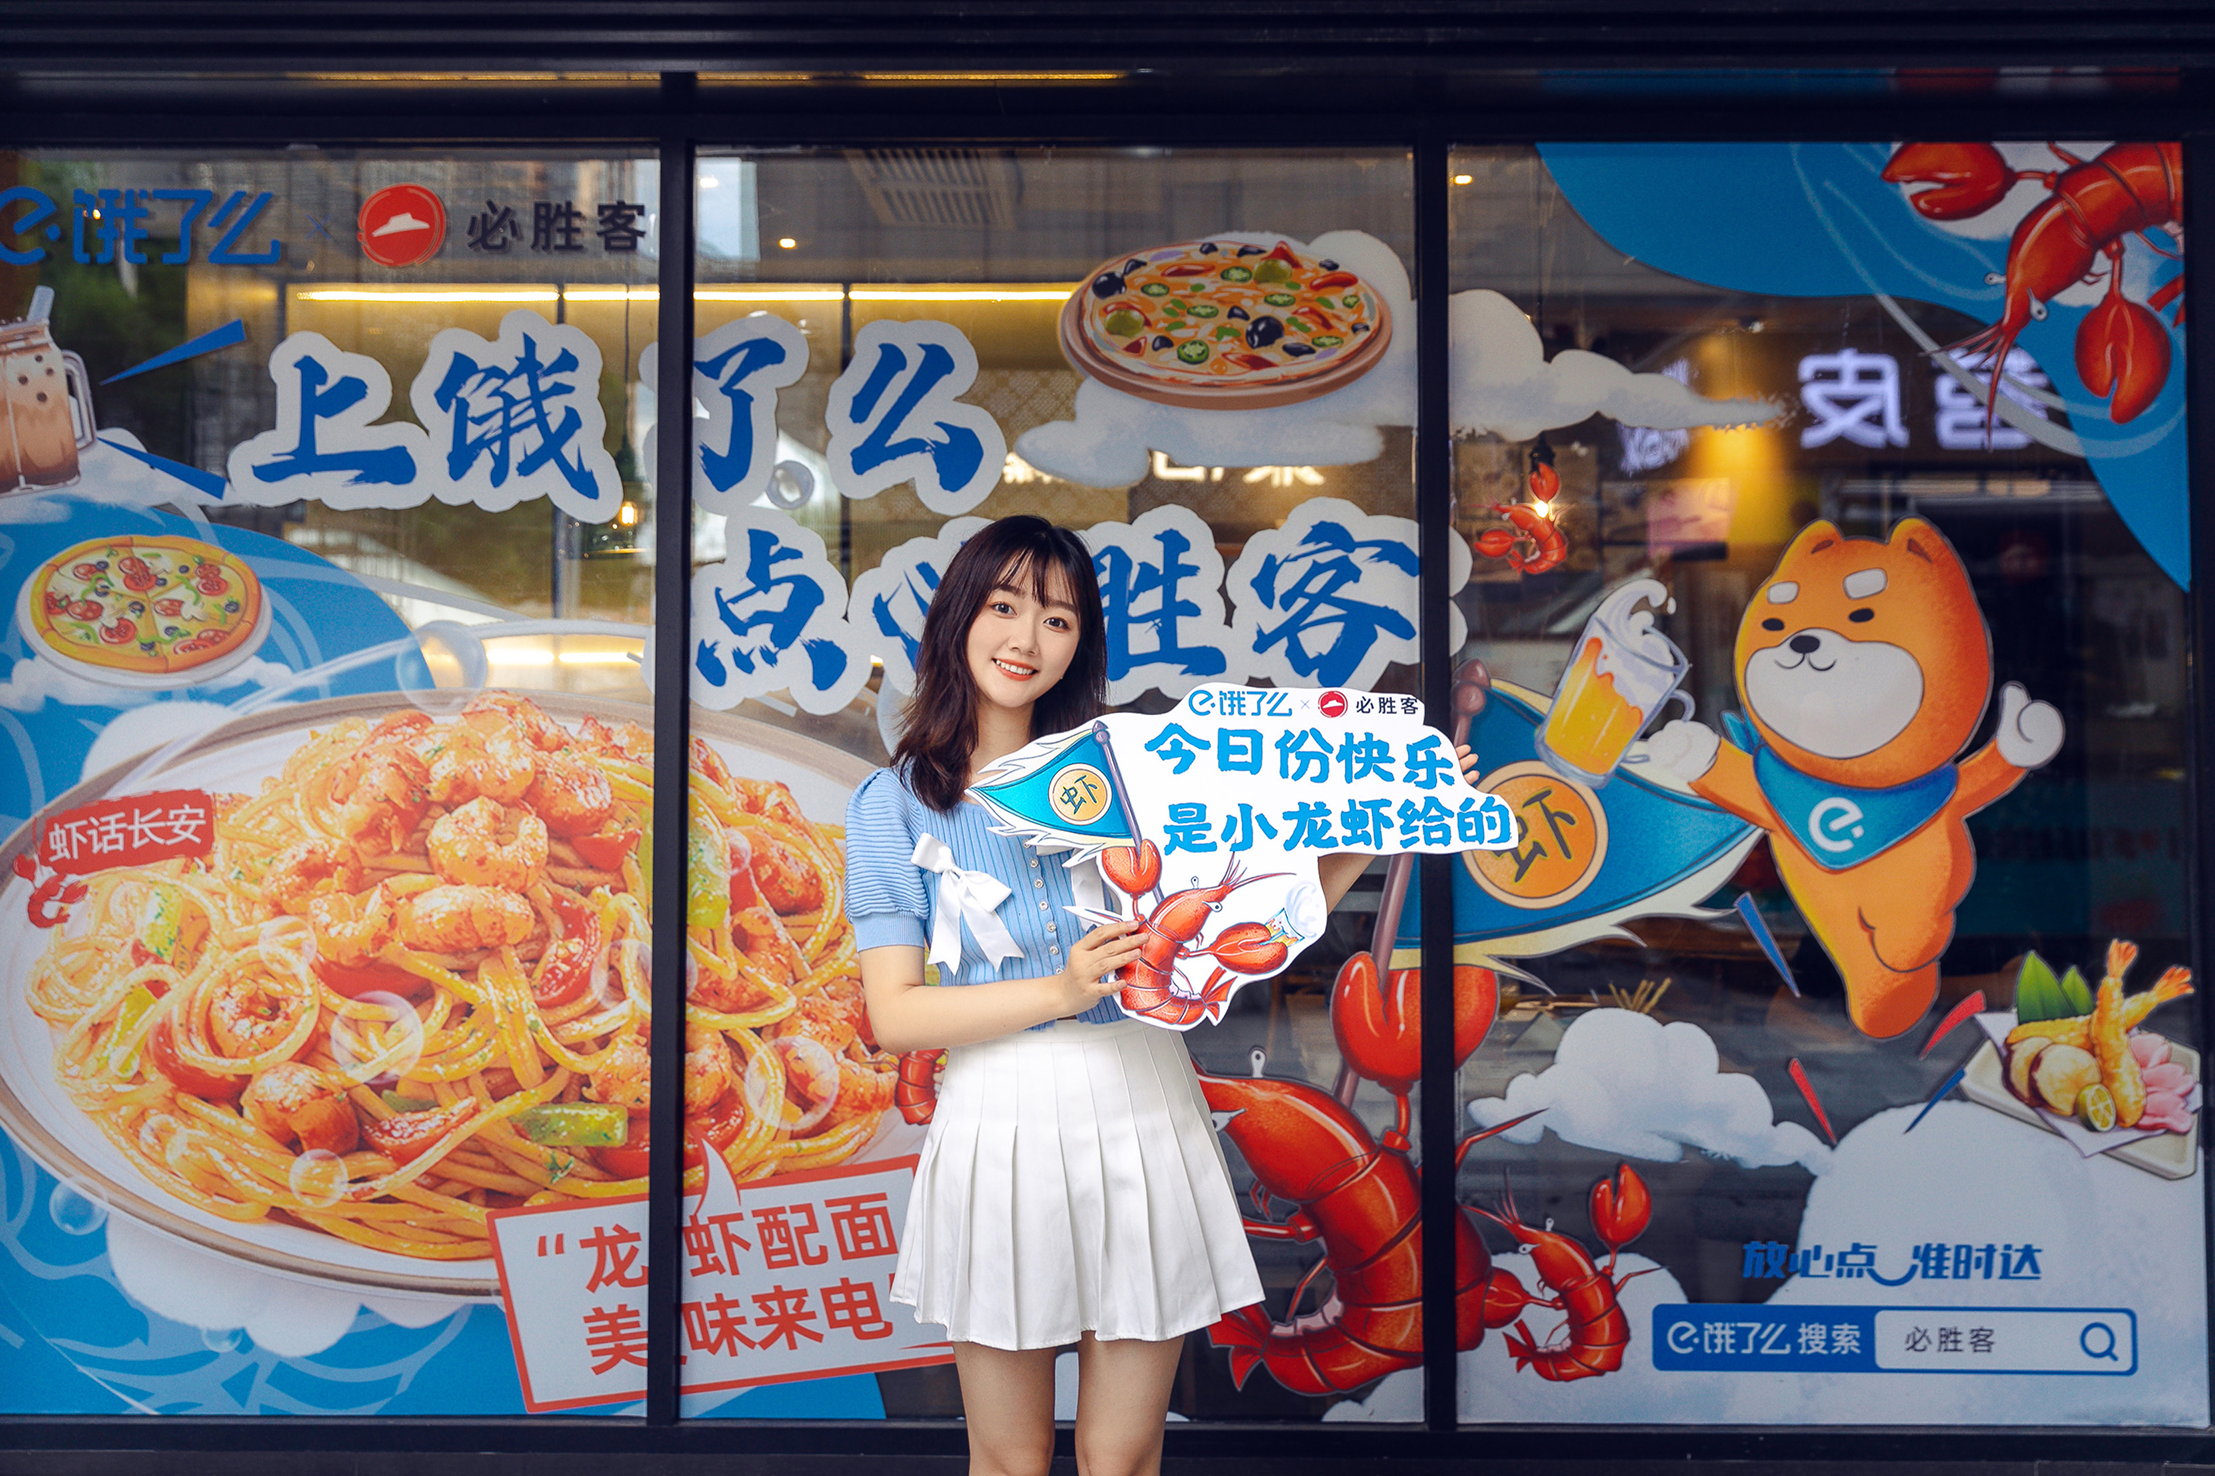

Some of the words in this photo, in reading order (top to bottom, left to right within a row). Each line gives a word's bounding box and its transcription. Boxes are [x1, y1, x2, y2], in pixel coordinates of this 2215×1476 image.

[467, 201, 647, 253] 必胜客
[696, 520, 1420, 688] 点胜客
[1355, 696, 1419, 715] 必胜客
[1144, 723, 1455, 790] 今日份快乐
[1059, 774, 1098, 815] 虾
[48, 803, 206, 862] 虾话长安
[1163, 796, 1513, 855] 是小龙虾给的
[1742, 1241, 1878, 1280] 放心点
[1910, 1243, 2043, 1281] 准时达
[1904, 1326, 1996, 1354] 必胜客
